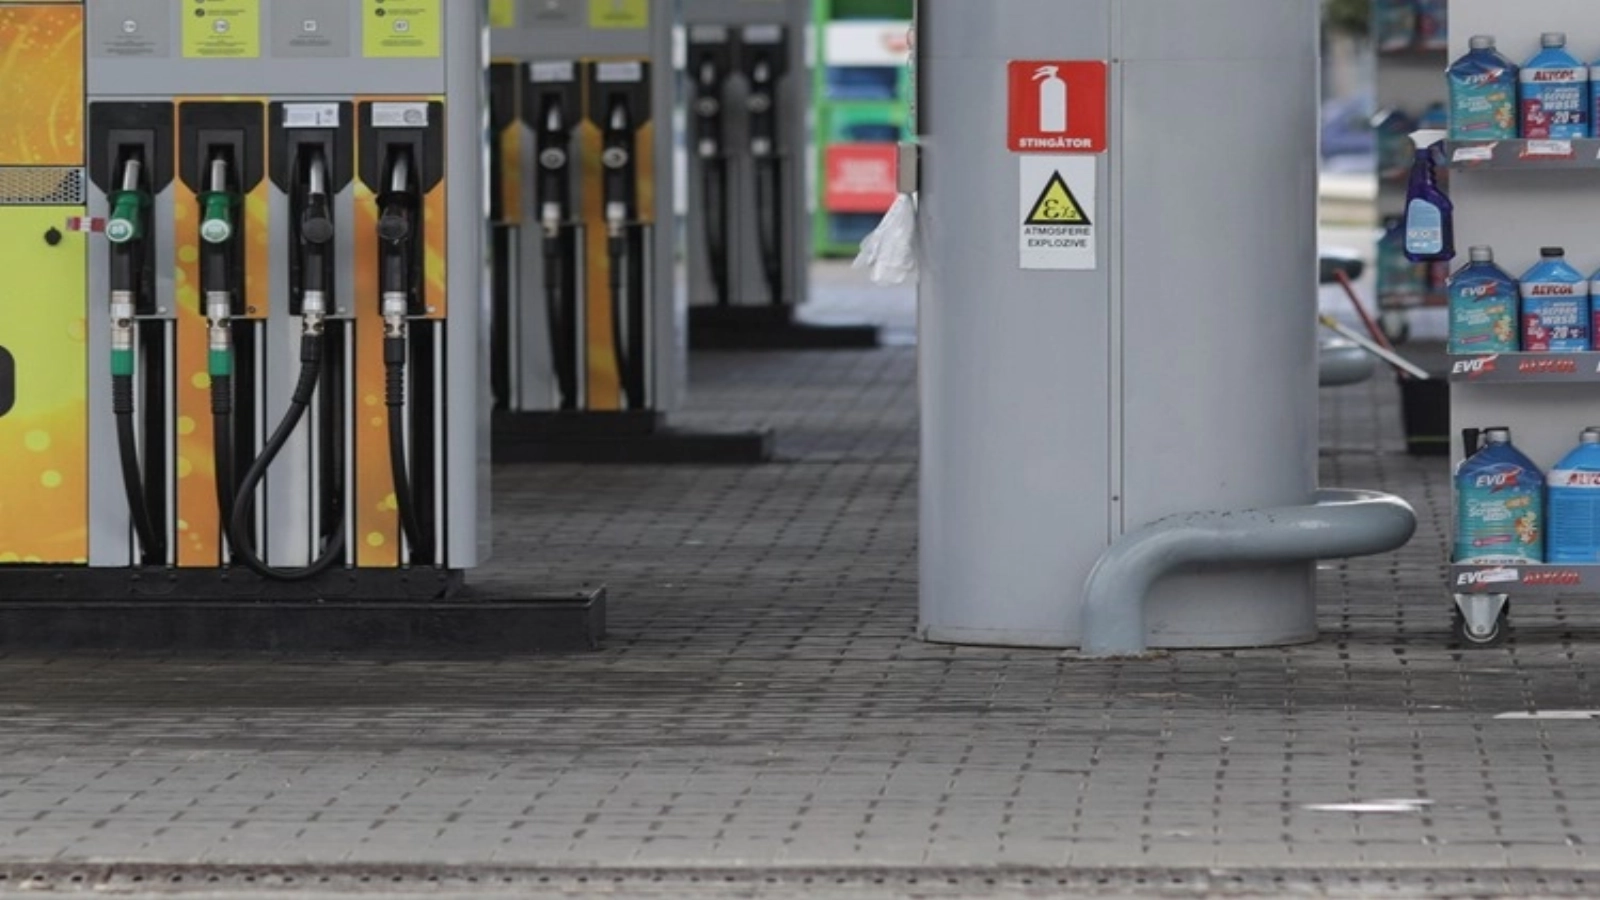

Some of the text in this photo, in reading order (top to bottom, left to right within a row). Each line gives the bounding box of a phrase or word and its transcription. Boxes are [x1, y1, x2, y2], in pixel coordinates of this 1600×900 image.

[1019, 137, 1092, 149] STINGĂTOR
[1024, 227, 1091, 236] ATMOSFERE
[1028, 238, 1087, 248] EXPLOZIVE
